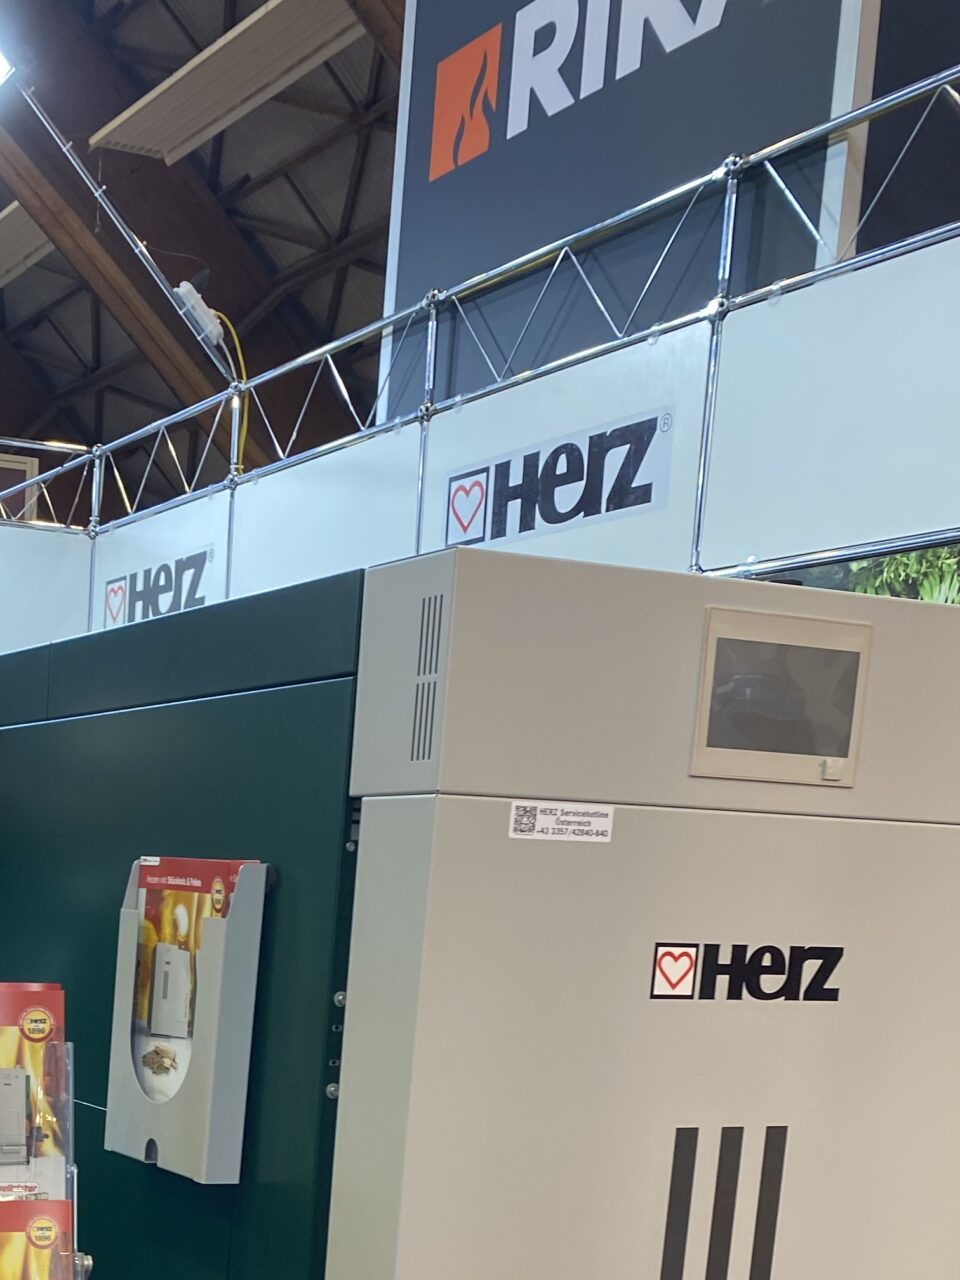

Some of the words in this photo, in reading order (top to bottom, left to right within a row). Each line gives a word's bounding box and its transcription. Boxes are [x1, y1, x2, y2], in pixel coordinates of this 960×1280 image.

[506, 0, 727, 139] RIK
[539, 807, 559, 816] HERZ
[560, 809, 609, 818] Servicehotline
[555, 816, 592, 827] Österreich
